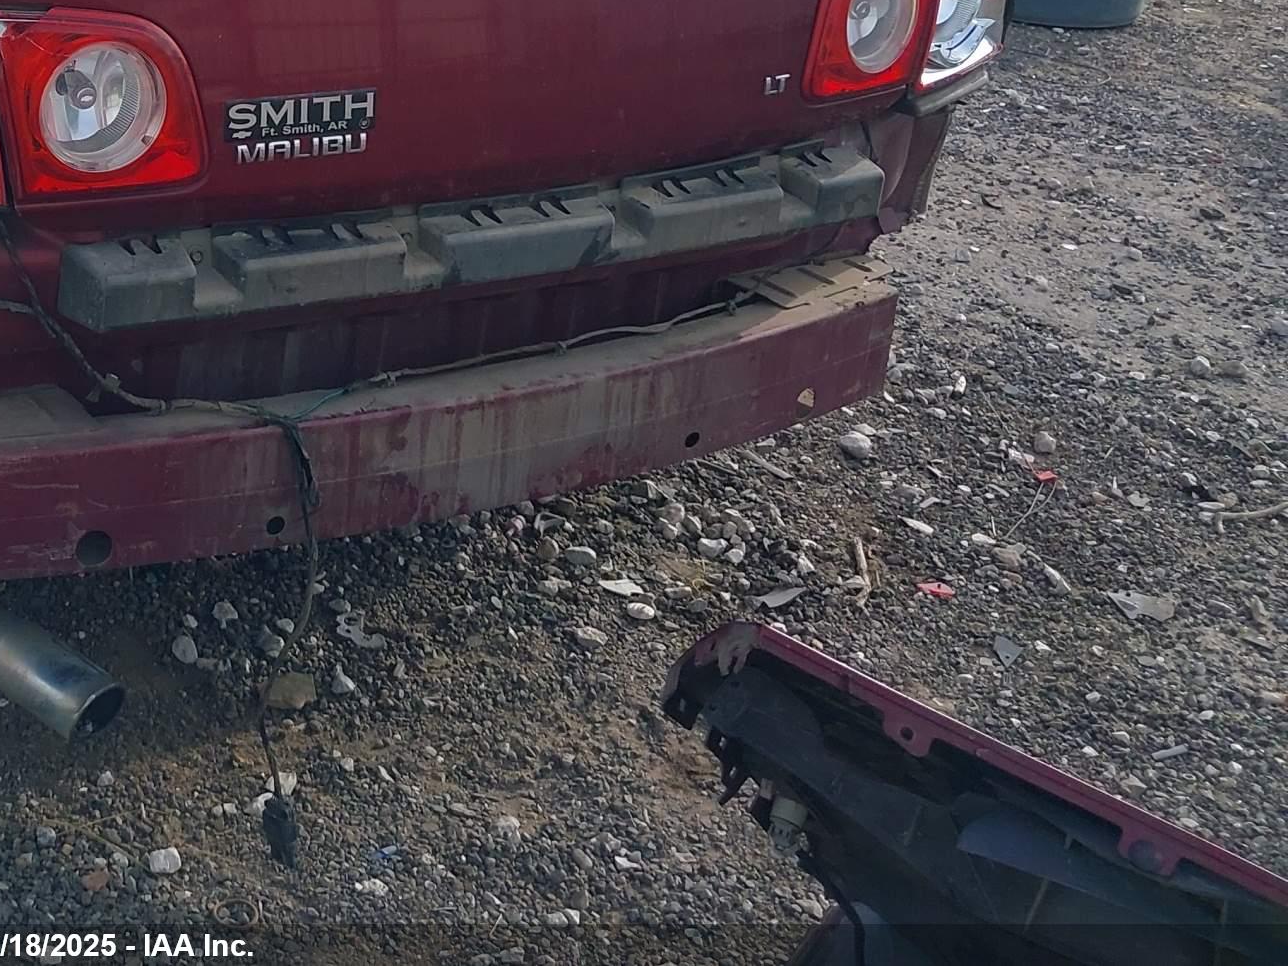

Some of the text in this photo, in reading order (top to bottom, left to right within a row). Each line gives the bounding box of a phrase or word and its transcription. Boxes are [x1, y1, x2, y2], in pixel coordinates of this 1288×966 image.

[764, 74, 791, 95] LT
[228, 92, 375, 130] SMITH
[262, 120, 348, 137] Ft. Smith, AR
[237, 133, 367, 164] MALIBU
